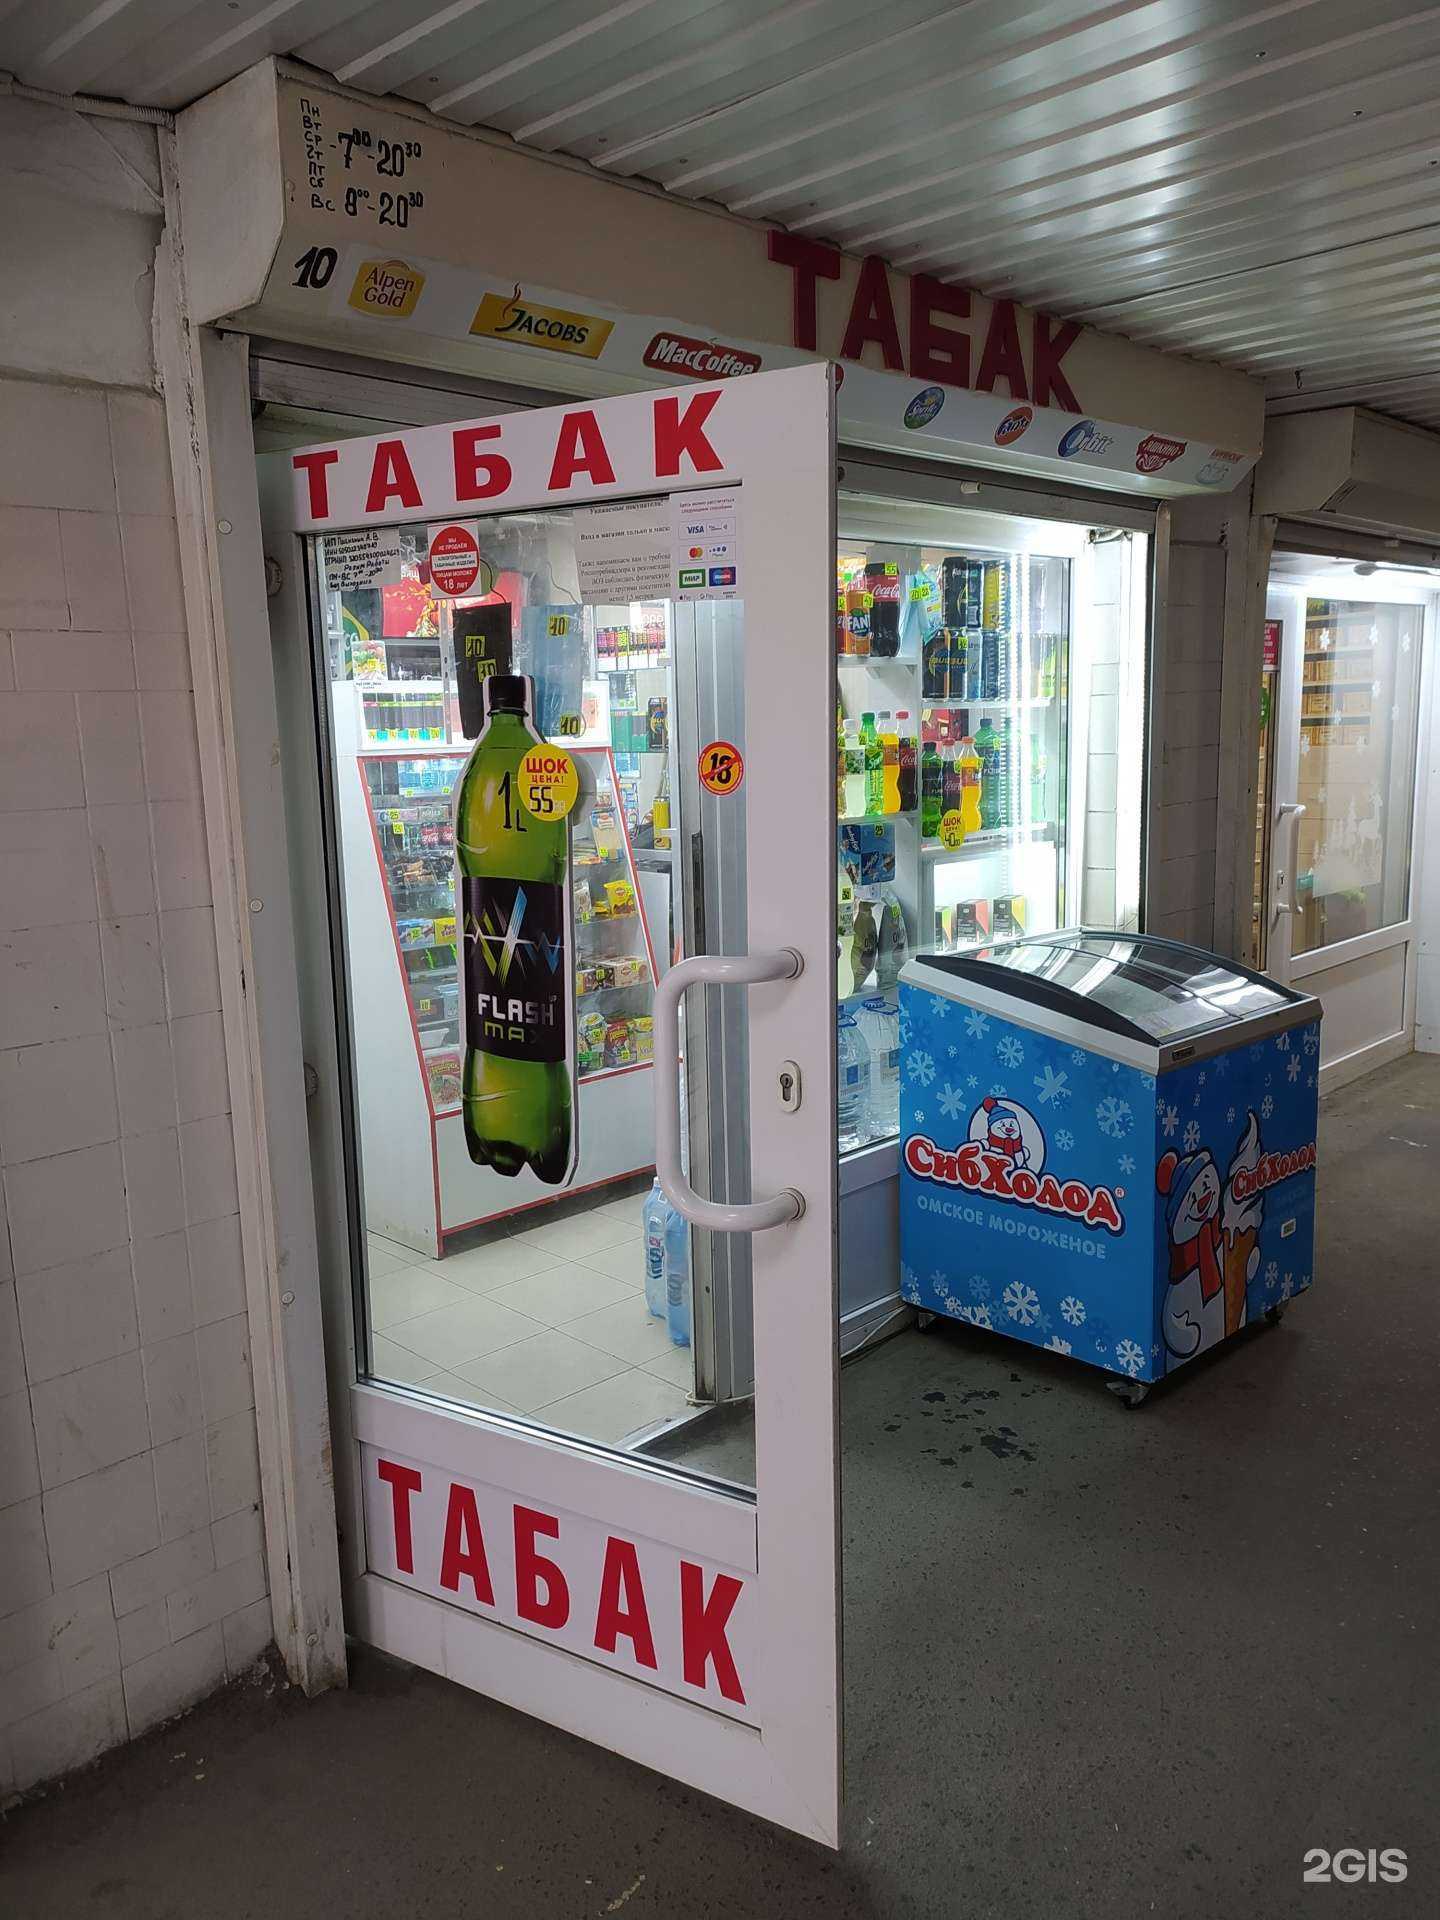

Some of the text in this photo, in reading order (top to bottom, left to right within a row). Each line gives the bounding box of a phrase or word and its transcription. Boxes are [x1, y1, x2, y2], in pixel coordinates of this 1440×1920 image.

[292, 246, 338, 289] 10
[365, 267, 414, 292] Alpen
[364, 286, 405, 308] Gold
[494, 307, 589, 344] JACOBS
[768, 229, 1083, 414] ТАБАК
[652, 338, 755, 377] MacCoffee
[293, 389, 725, 520] ТАБАК
[687, 526, 704, 534] VISA
[444, 578, 454, 590] 18
[684, 574, 700, 582] МИР
[526, 758, 568, 774] ШОК
[531, 774, 565, 784] ЦЕНА!
[529, 786, 554, 813] 55
[943, 817, 961, 827] ШОК
[478, 993, 554, 1026] FLASH
[906, 1137, 1121, 1229] СибХолод
[917, 1195, 984, 1226] ОМСКОЕ
[988, 1213, 1106, 1260] МОРОЖЕНОЕ
[378, 1458, 747, 1706] ТАБАК
